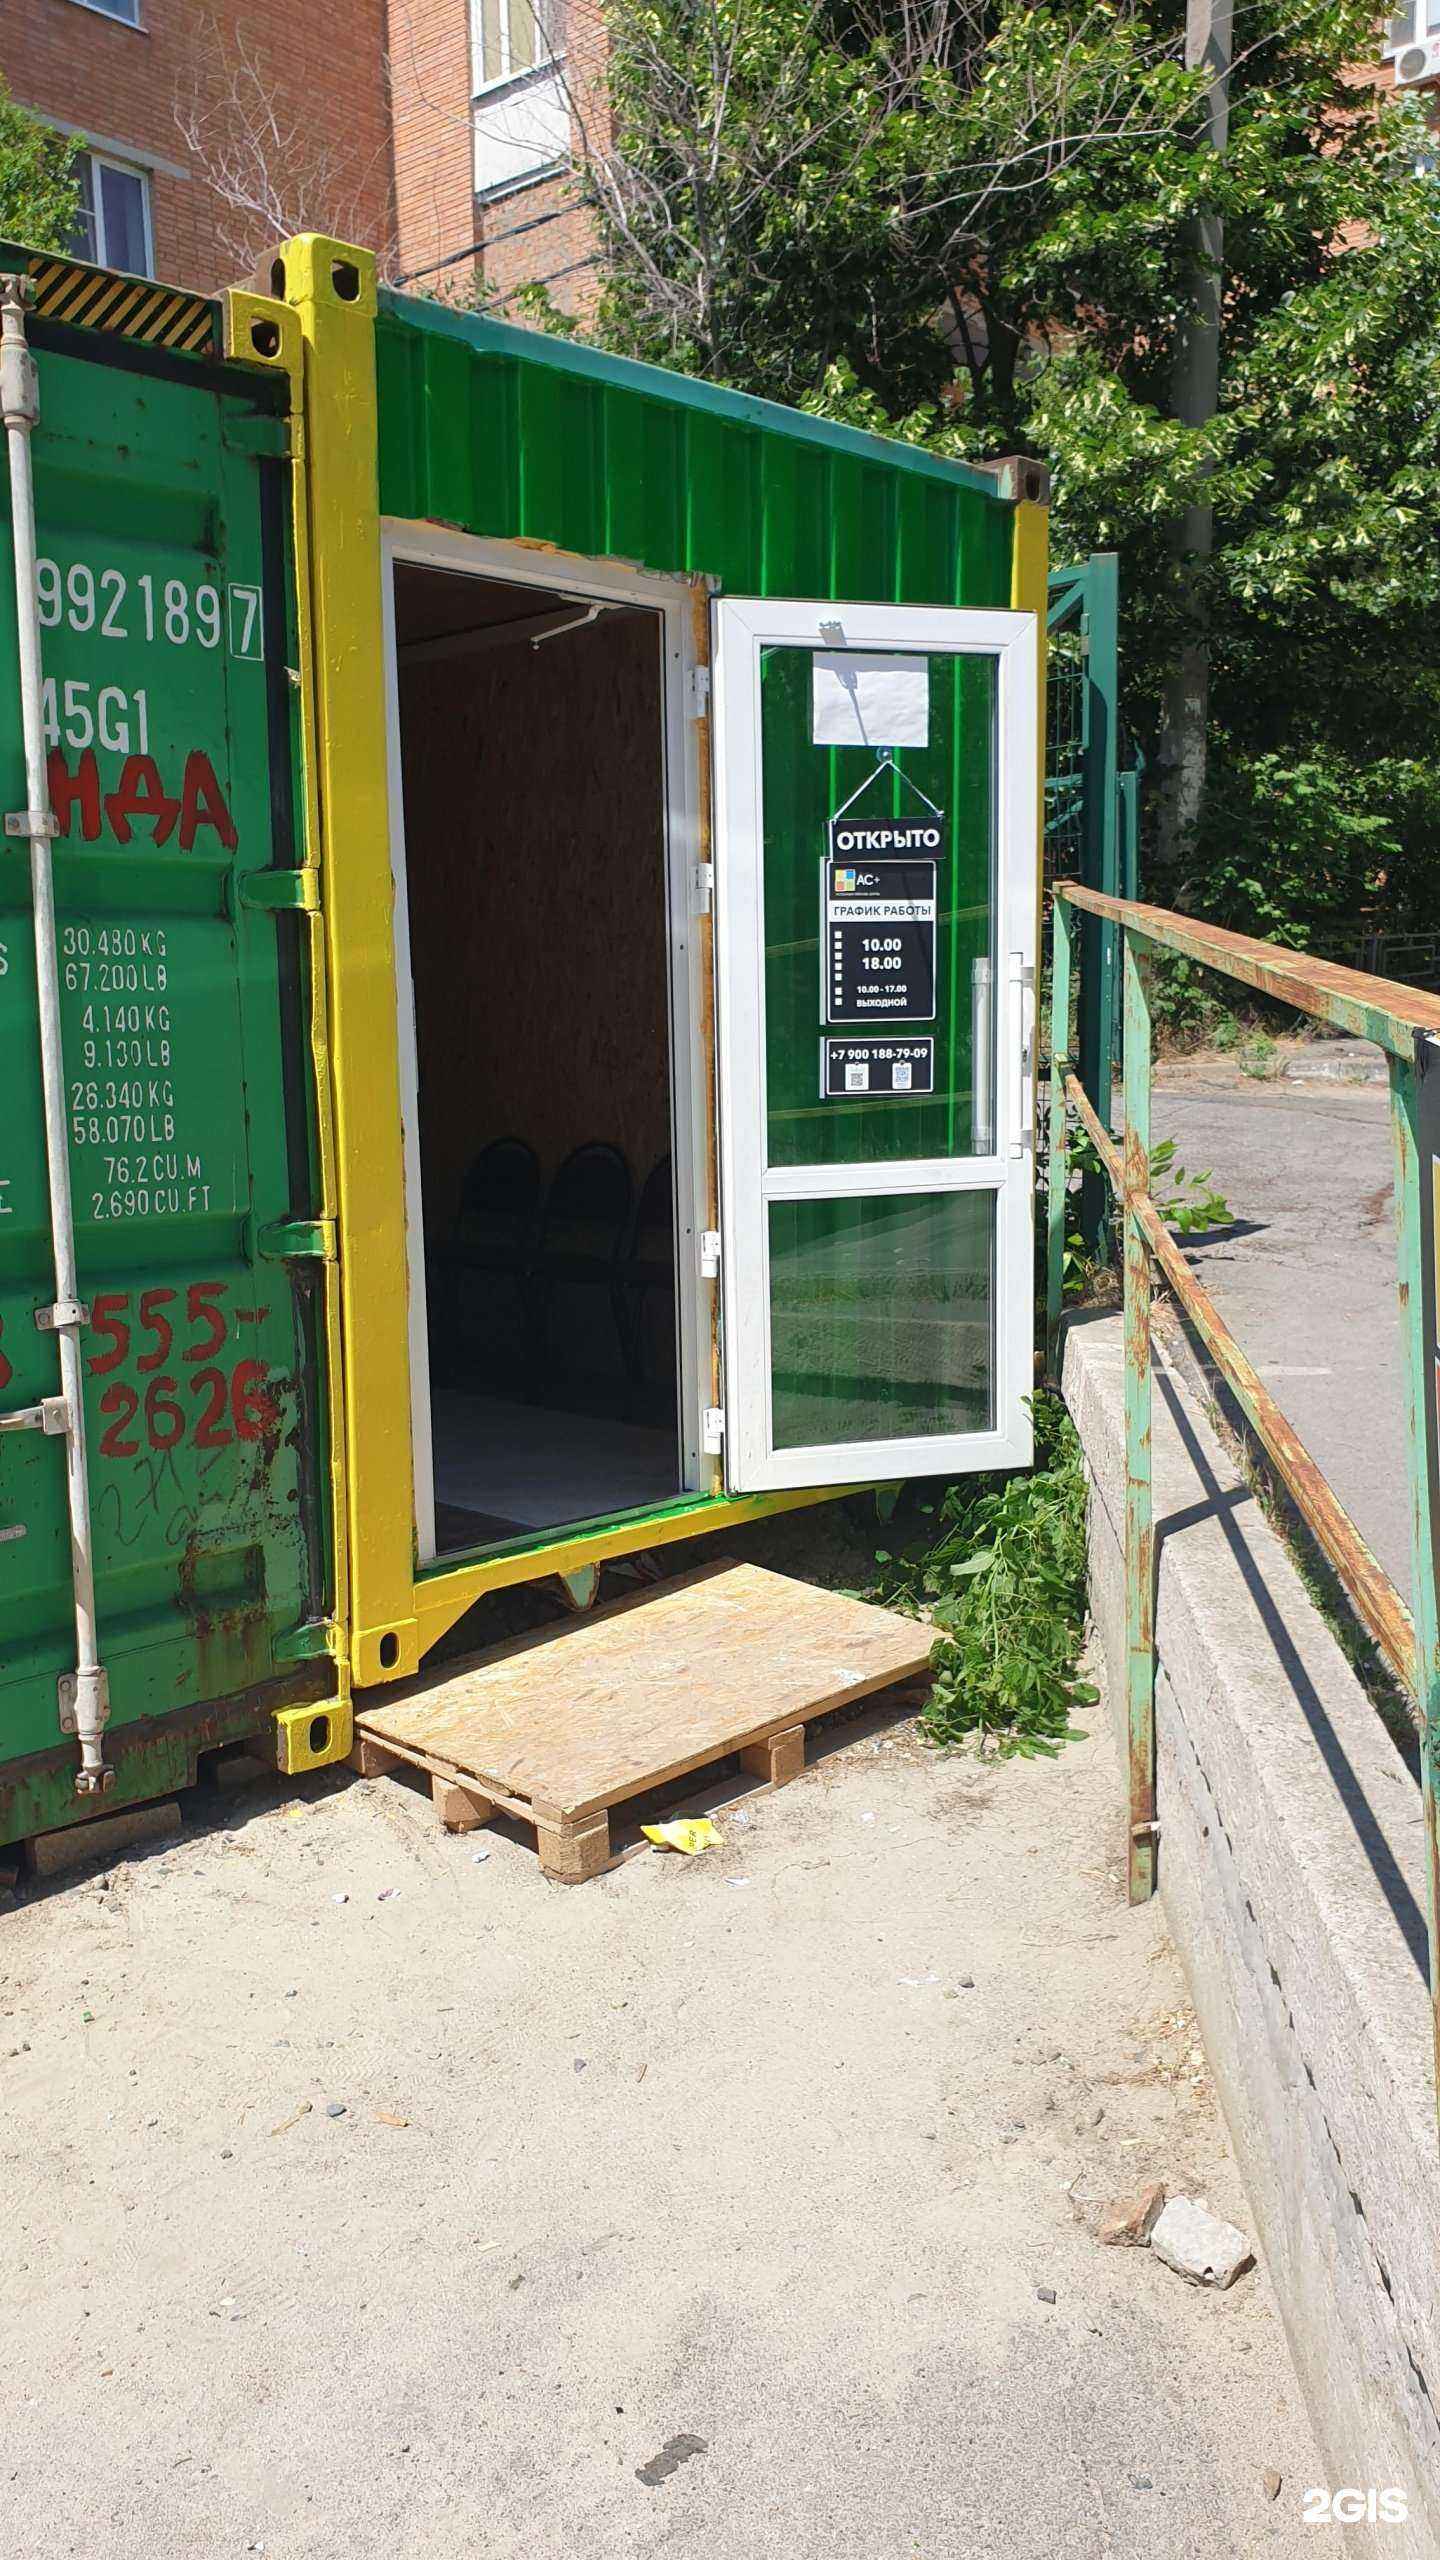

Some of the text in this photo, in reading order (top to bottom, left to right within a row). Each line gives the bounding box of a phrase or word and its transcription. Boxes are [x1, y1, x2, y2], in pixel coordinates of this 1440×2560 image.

[40, 677, 148, 755] 45G1
[836, 828, 940, 851] ОТКРЫТО
[833, 905, 931, 917] ГРАФИК РАБОТЫ
[861, 938, 902, 952] 10.00
[861, 956, 902, 970] 18.00
[856, 996, 908, 1008] ВЫХОДНОЙ
[830, 1048, 928, 1060] +7 900 188-79-09
[103, 1156, 149, 1184] 76.2
[100, 1360, 280, 1458] 2626
